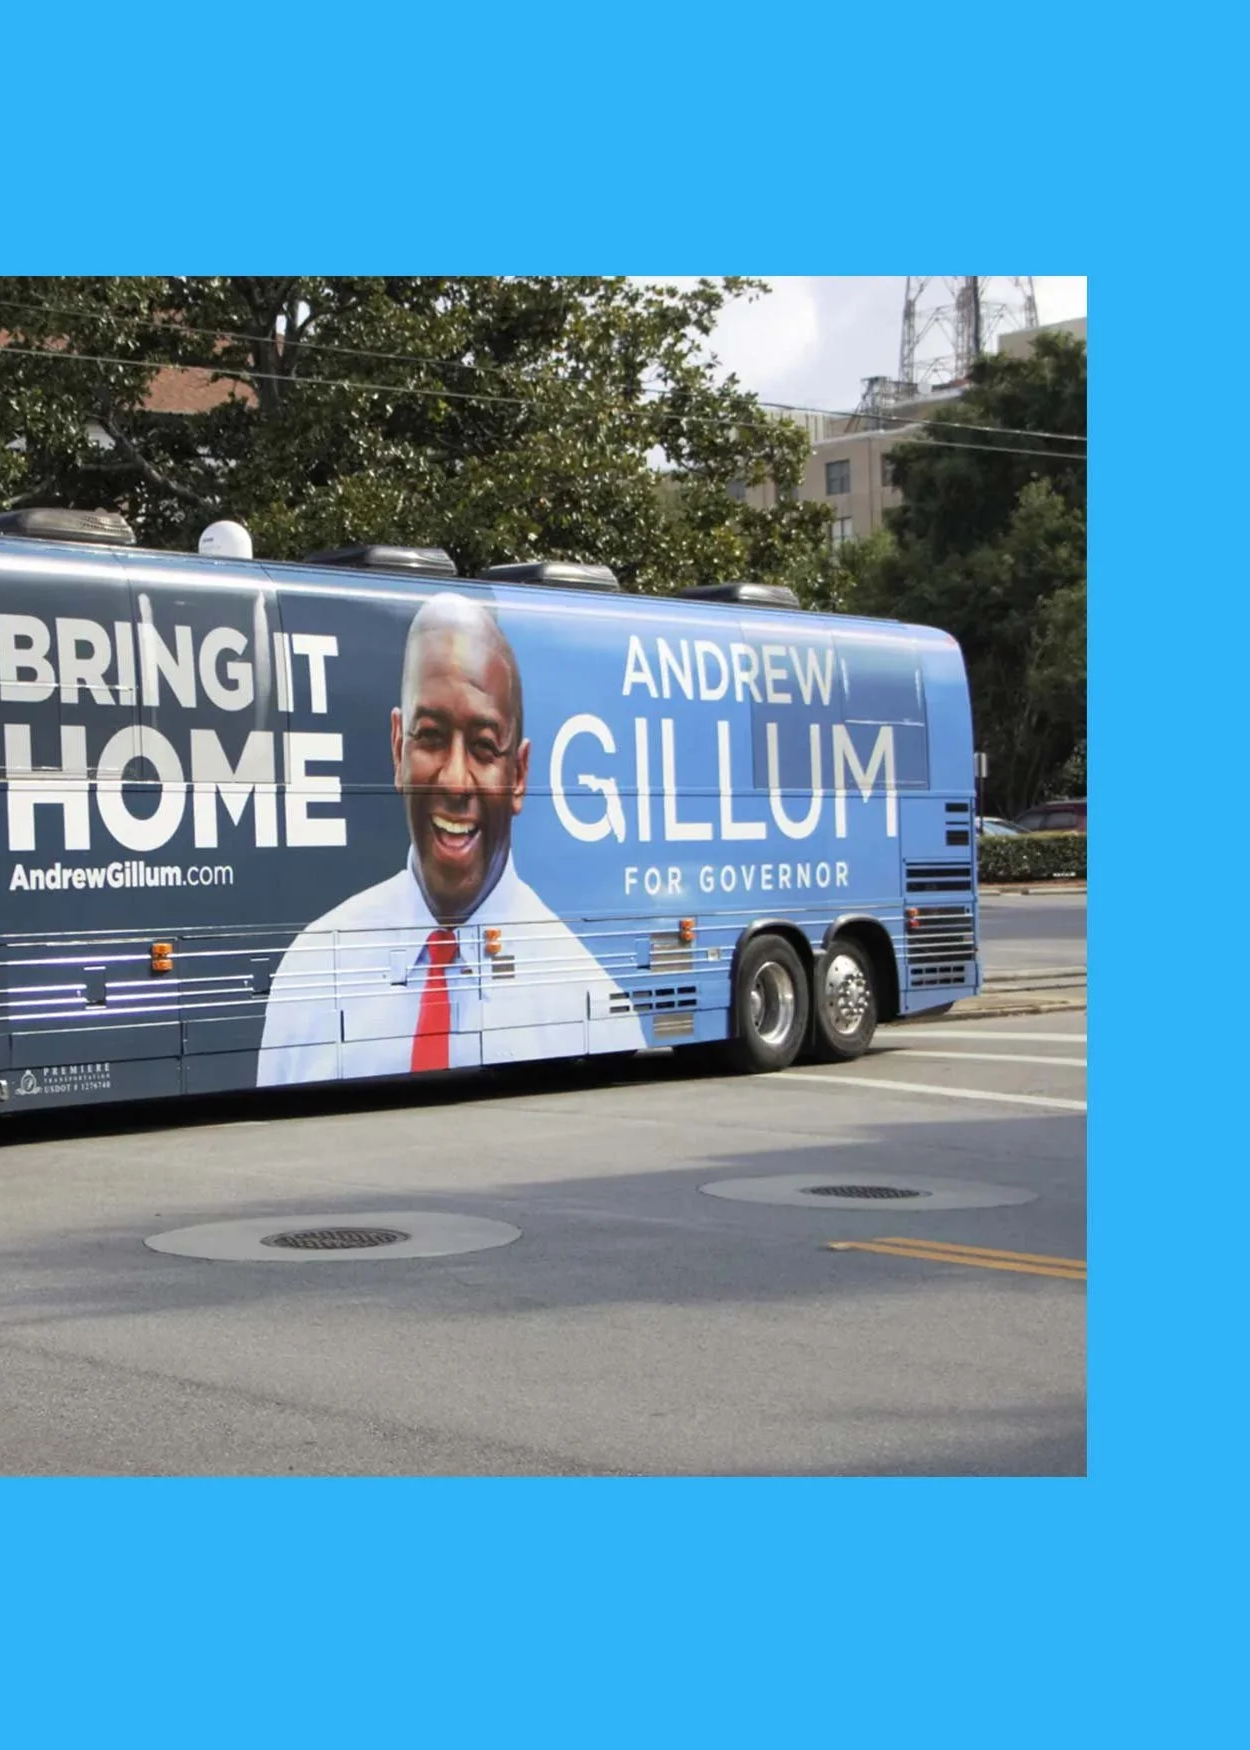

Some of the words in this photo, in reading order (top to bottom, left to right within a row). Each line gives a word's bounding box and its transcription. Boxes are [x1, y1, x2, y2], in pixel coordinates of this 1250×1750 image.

[273, 632, 338, 713] IT
[622, 635, 835, 706] ANDREW
[4, 724, 347, 852] HOME
[550, 713, 898, 844] GILLUM
[9, 861, 234, 891] AndrewGillum.com
[625, 866, 682, 895] FOR
[700, 861, 849, 893] GOVERNOR
[43, 1062, 110, 1077] PREMIERE
